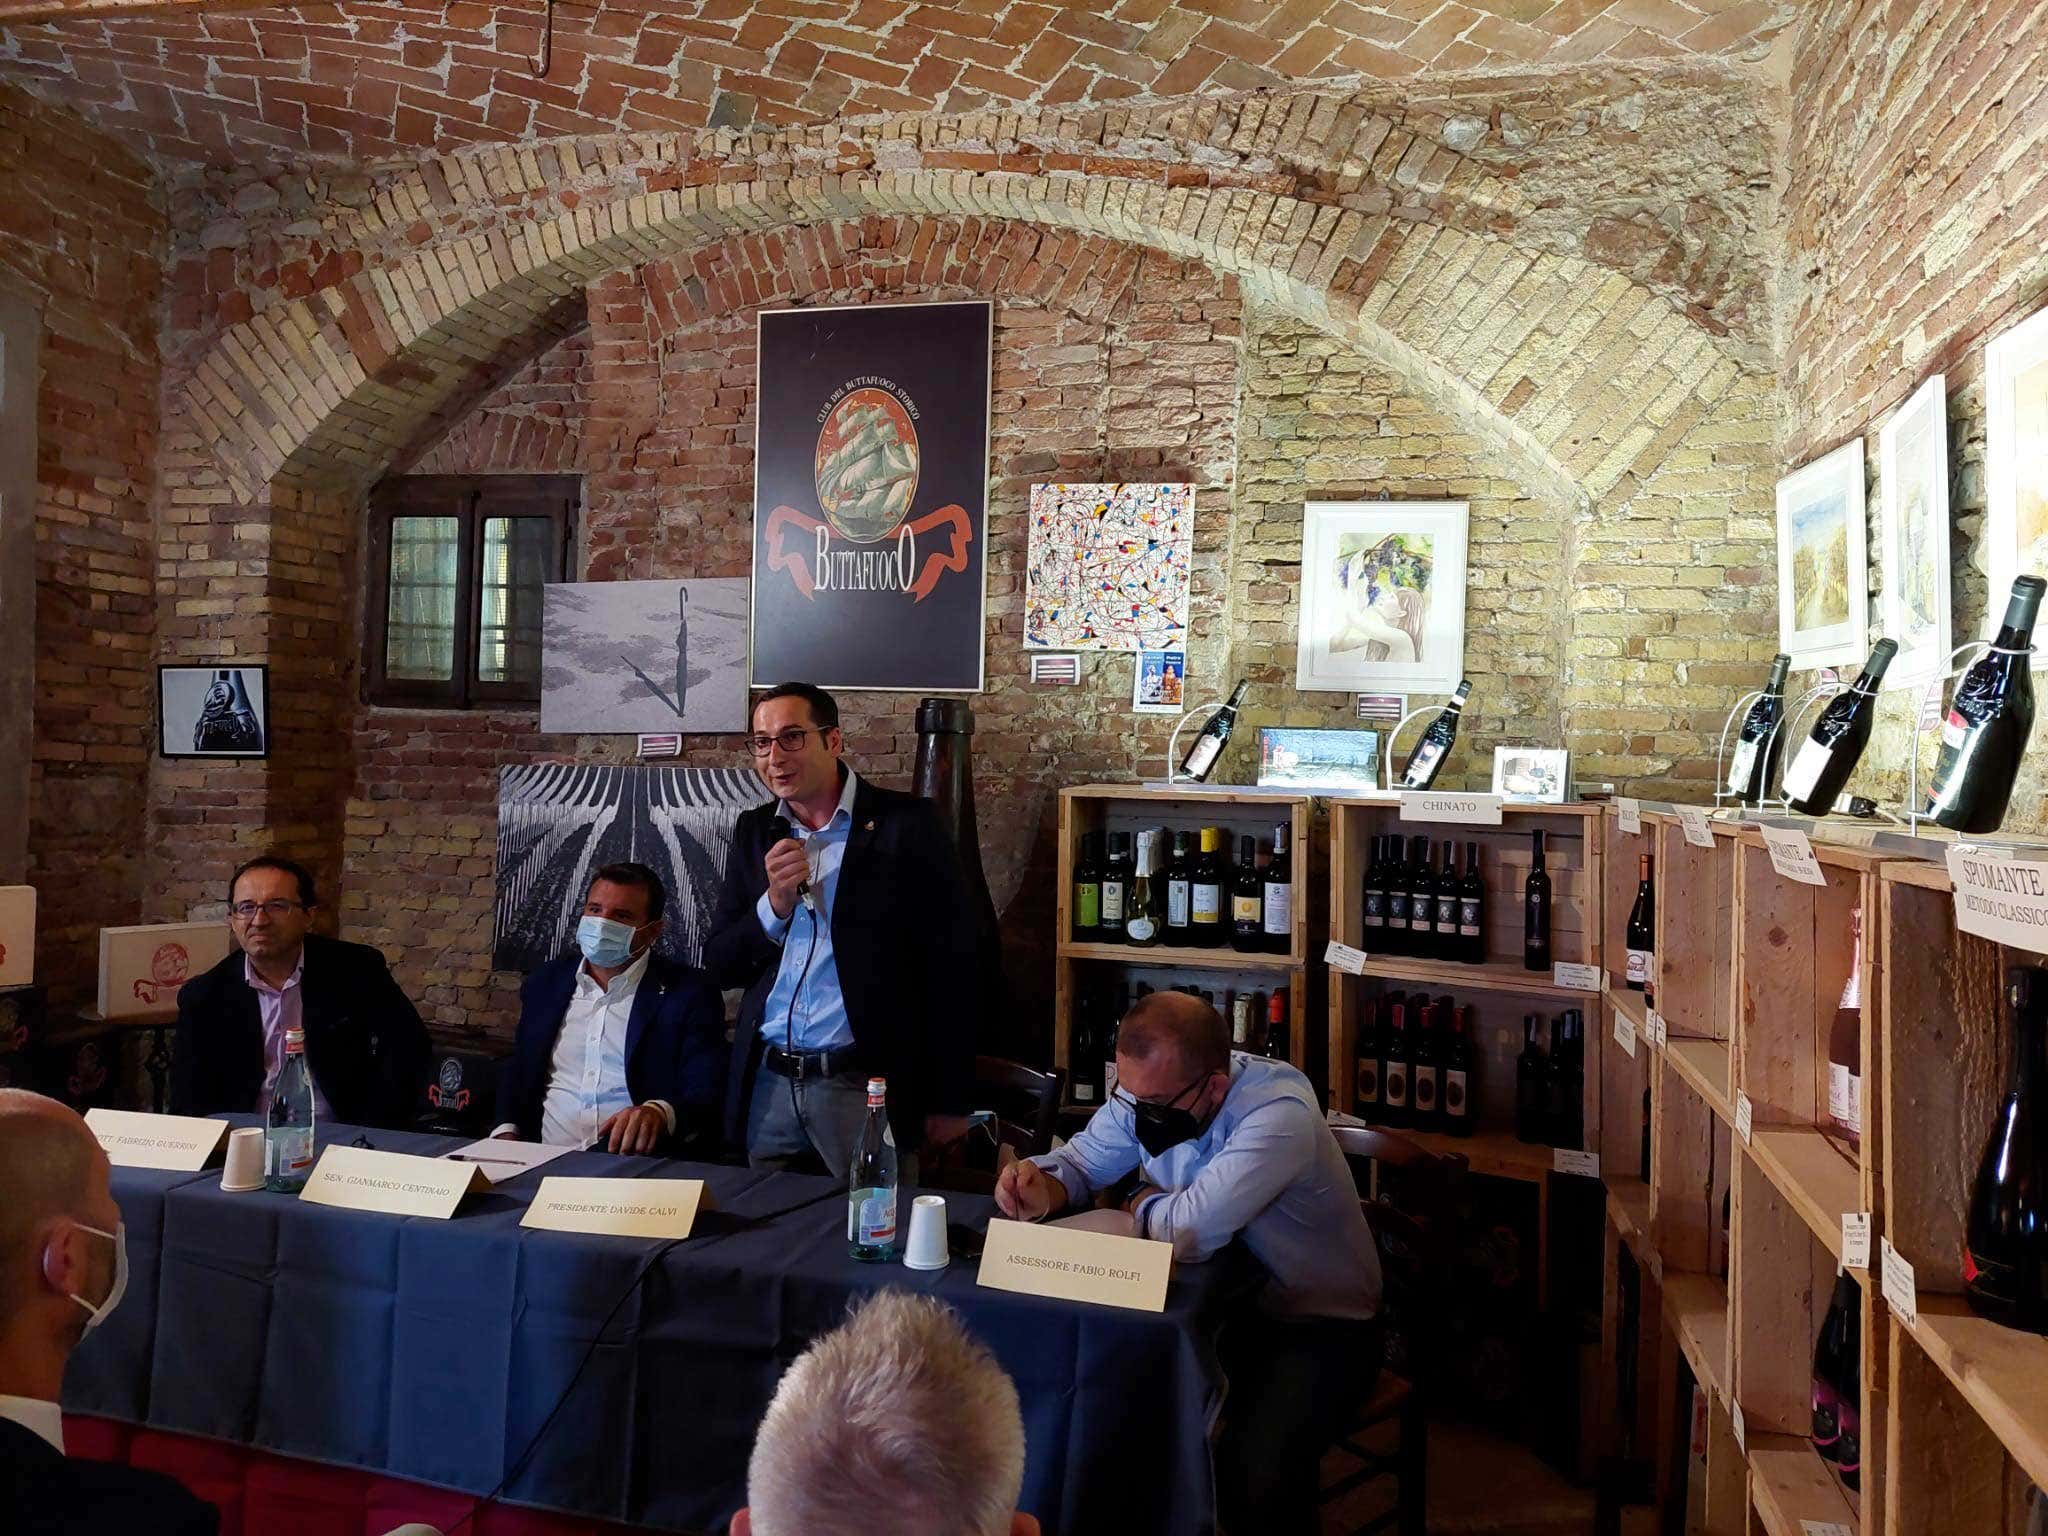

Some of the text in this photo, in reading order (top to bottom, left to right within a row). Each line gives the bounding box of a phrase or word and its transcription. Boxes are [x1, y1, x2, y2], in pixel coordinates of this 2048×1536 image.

[817, 376, 920, 423] CLUB DEL BUTTAFUOCO STORICO
[1422, 801, 1477, 812] CHINATO
[1962, 859, 2044, 897] SPUMANTE
[1964, 893, 1998, 917] METODO
[116, 1136, 155, 1148] FABRIZIO
[323, 1172, 450, 1197] SEN. GIANMARCO CENTINAIO
[546, 1203, 677, 1217] PRESIDENTE DAVIDE CALVI
[1006, 1254, 1141, 1282] ASSESSORE FABIO ROLFI
